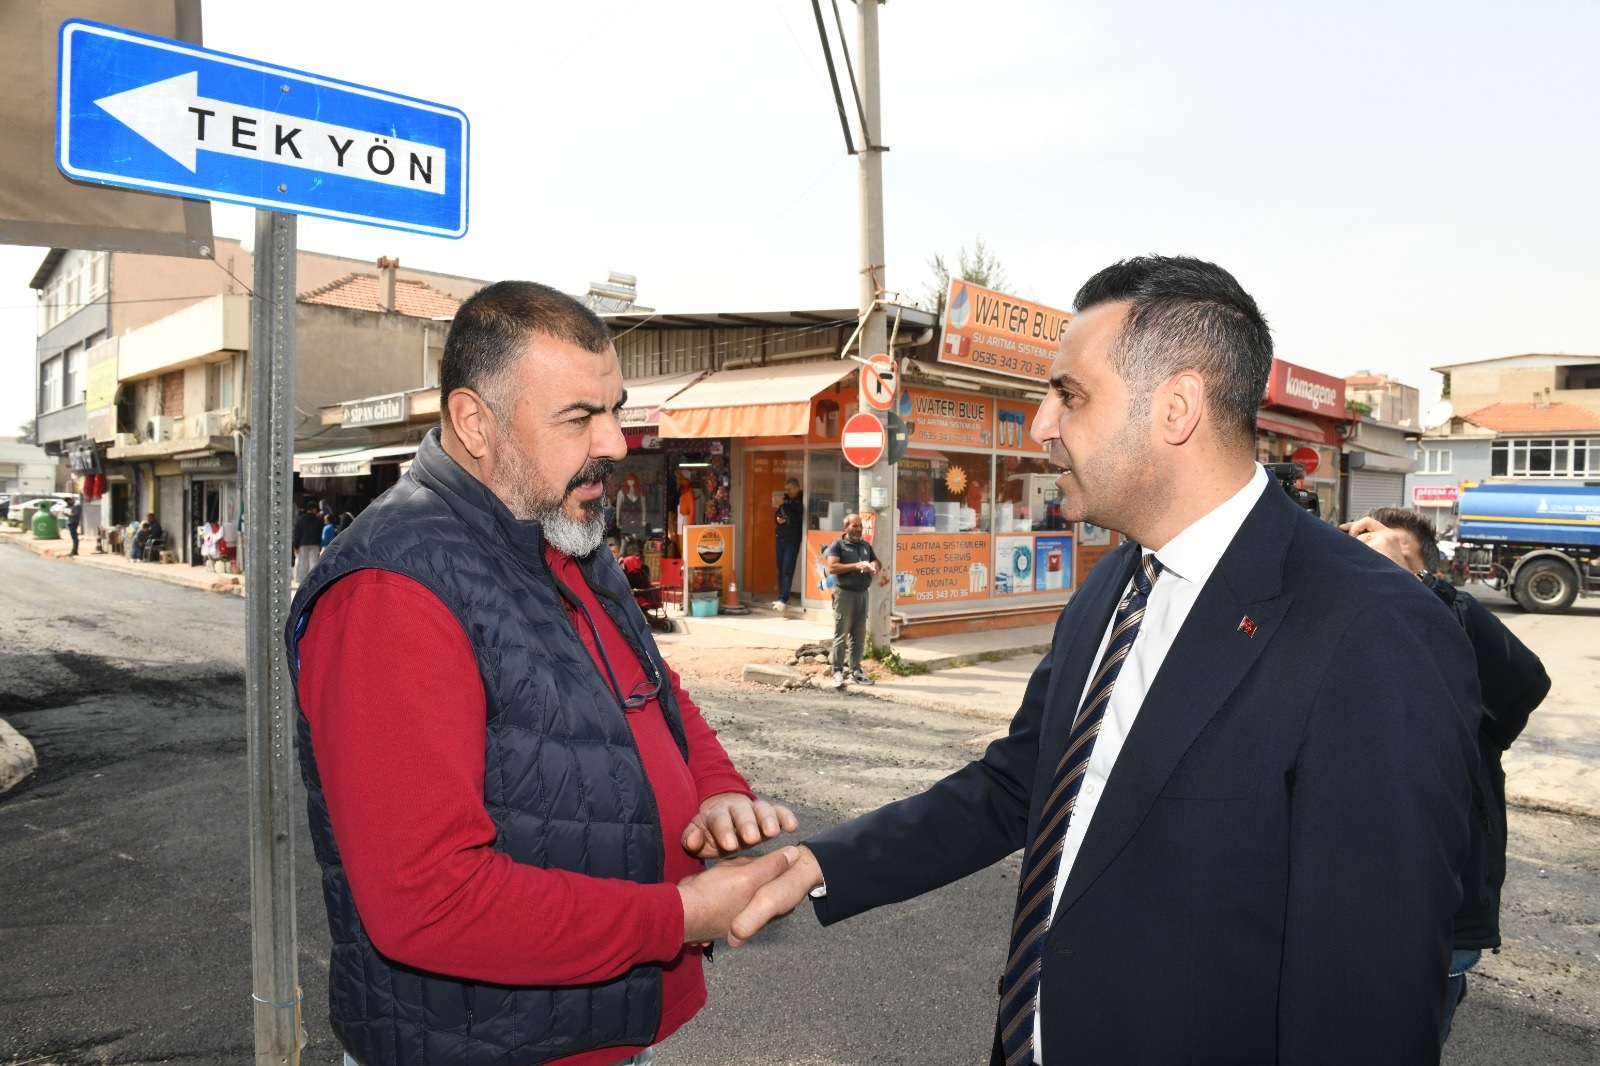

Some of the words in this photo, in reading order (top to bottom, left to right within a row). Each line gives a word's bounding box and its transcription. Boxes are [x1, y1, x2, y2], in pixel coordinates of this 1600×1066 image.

[188, 106, 303, 160] TEK
[327, 134, 432, 185] YÖN
[974, 293, 1030, 336] WATER
[1031, 310, 1069, 343] BLUE
[972, 332, 985, 344] SU
[986, 335, 1016, 351] ARITMA
[1017, 341, 1059, 361] SİSTEMLER
[971, 349, 997, 366] 0535
[999, 355, 1018, 370] 343
[1020, 359, 1033, 373] 70
[1034, 363, 1047, 376] 36
[1285, 366, 1337, 410] komagene
[915, 396, 955, 417] WATER
[958, 402, 985, 421] BLUE
[917, 417, 926, 425] SU
[918, 430, 937, 441] 0535
[938, 432, 952, 442] 343
[954, 433, 963, 443] 70
[964, 435, 974, 444] 36
[896, 542, 908, 551] SU
[911, 541, 941, 551] ARITMA
[916, 566, 940, 576] YEDEK
[943, 565, 968, 575] PARÇA
[926, 578, 958, 588] MONTAJ
[916, 590, 934, 601] 0535
[935, 589, 948, 599] 343
[949, 588, 959, 598] 70
[959, 588, 969, 598] 36
